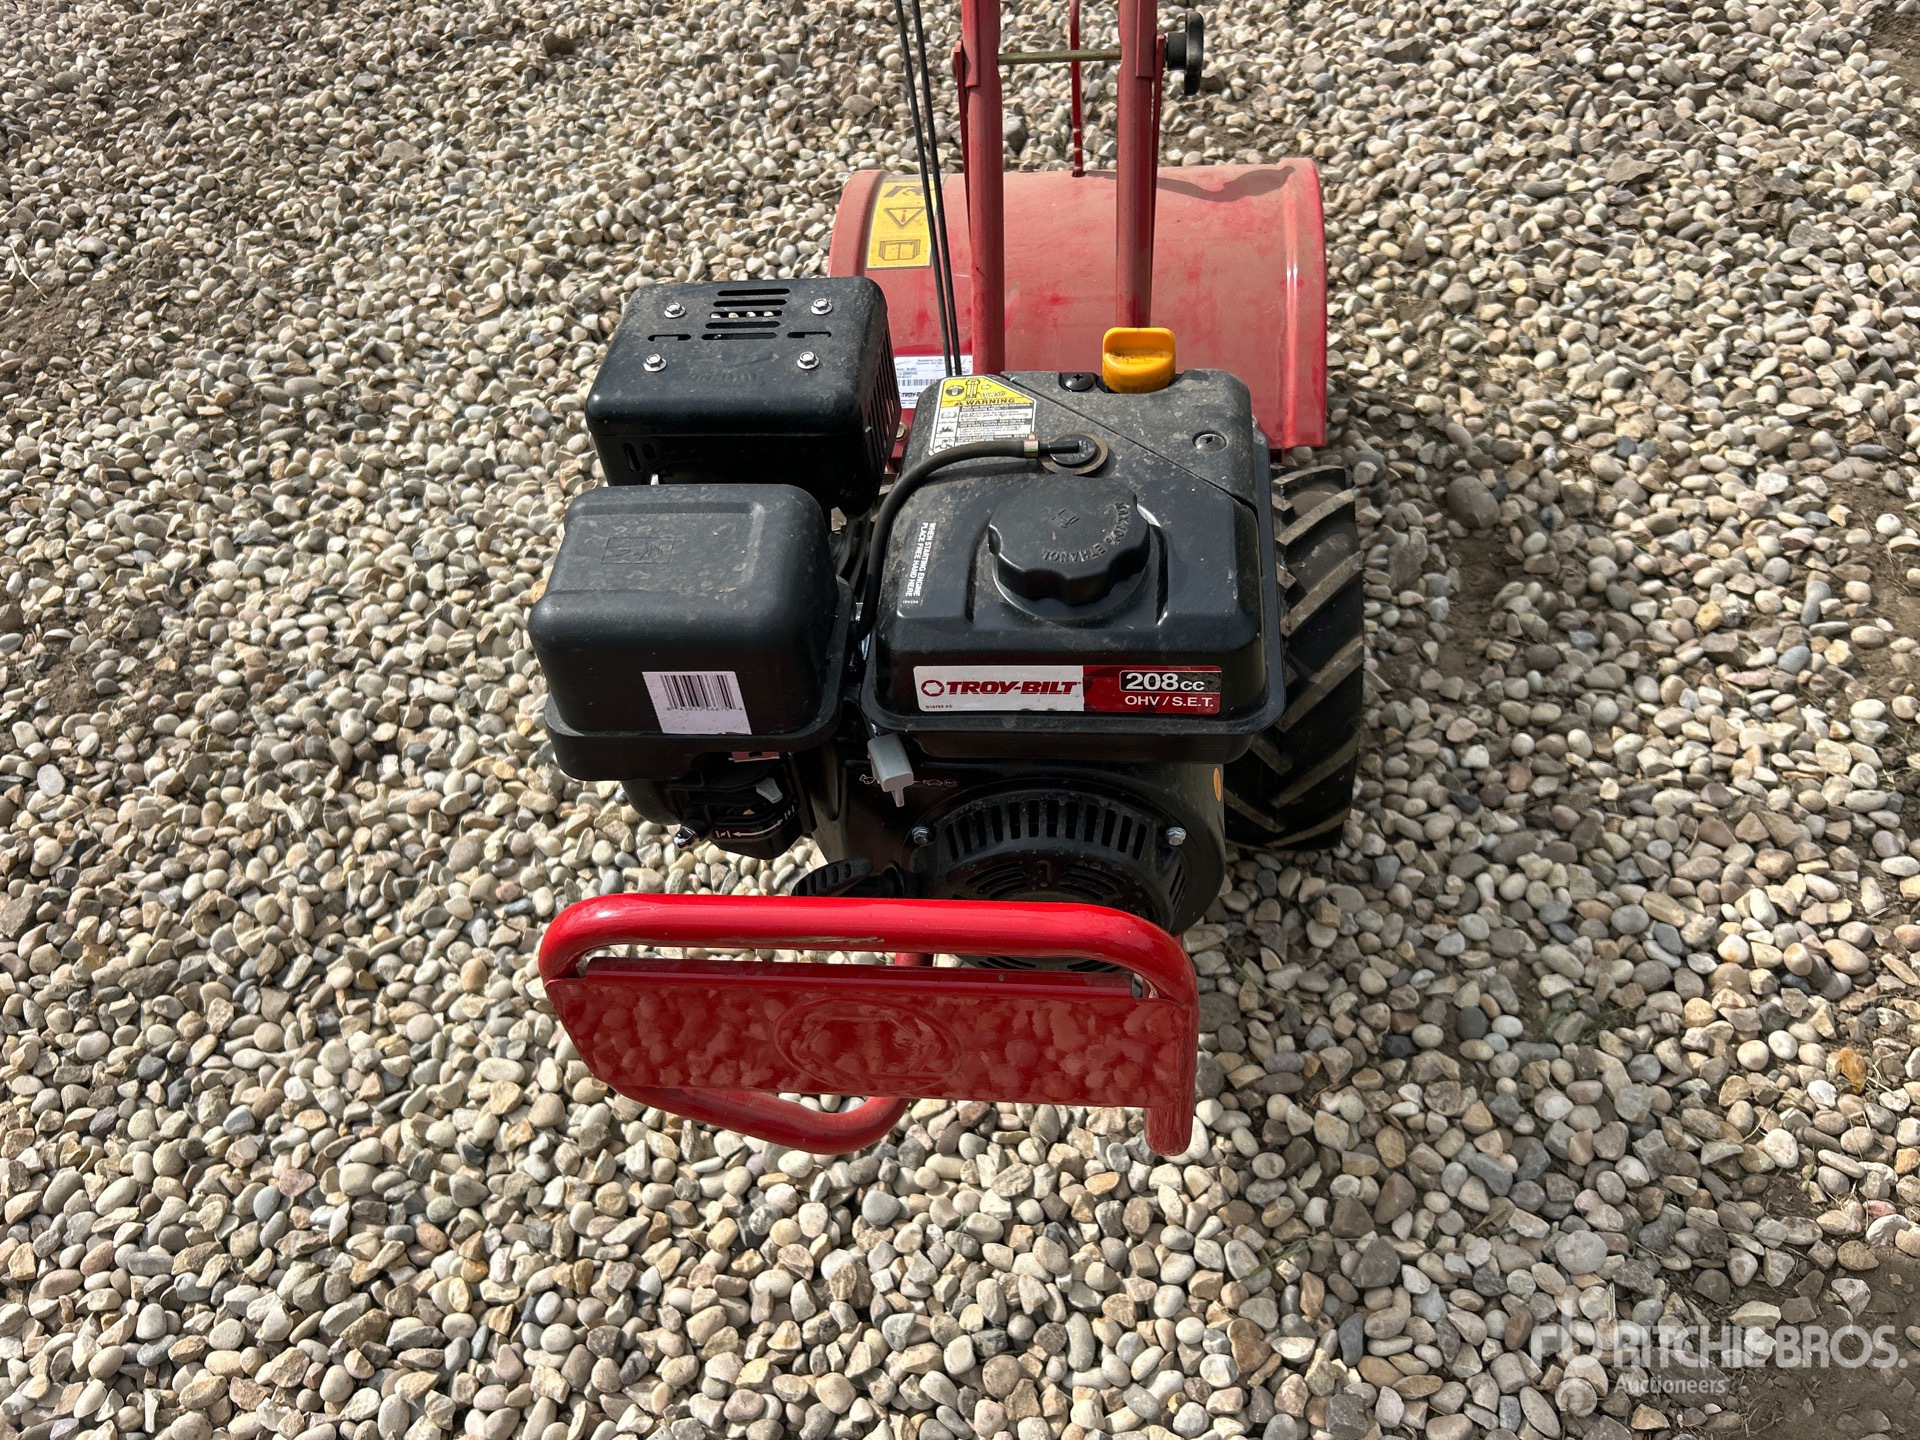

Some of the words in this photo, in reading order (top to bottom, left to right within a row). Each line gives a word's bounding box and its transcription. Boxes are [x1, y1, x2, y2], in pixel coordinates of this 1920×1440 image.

[966, 398, 1015, 406] WARNING
[918, 522, 928, 542] PLACE
[926, 522, 936, 540] WHEN
[914, 543, 924, 560] FREE
[919, 541, 932, 571] STARTING
[1042, 542, 1106, 562] ETHANOL
[910, 560, 920, 578] HAND
[905, 579, 915, 597] HERE
[913, 572, 925, 597] ENGINE
[946, 681, 1078, 695] TROY-BILT
[1124, 695, 1160, 706] OHV
[1172, 696, 1214, 707] S.E.T.
